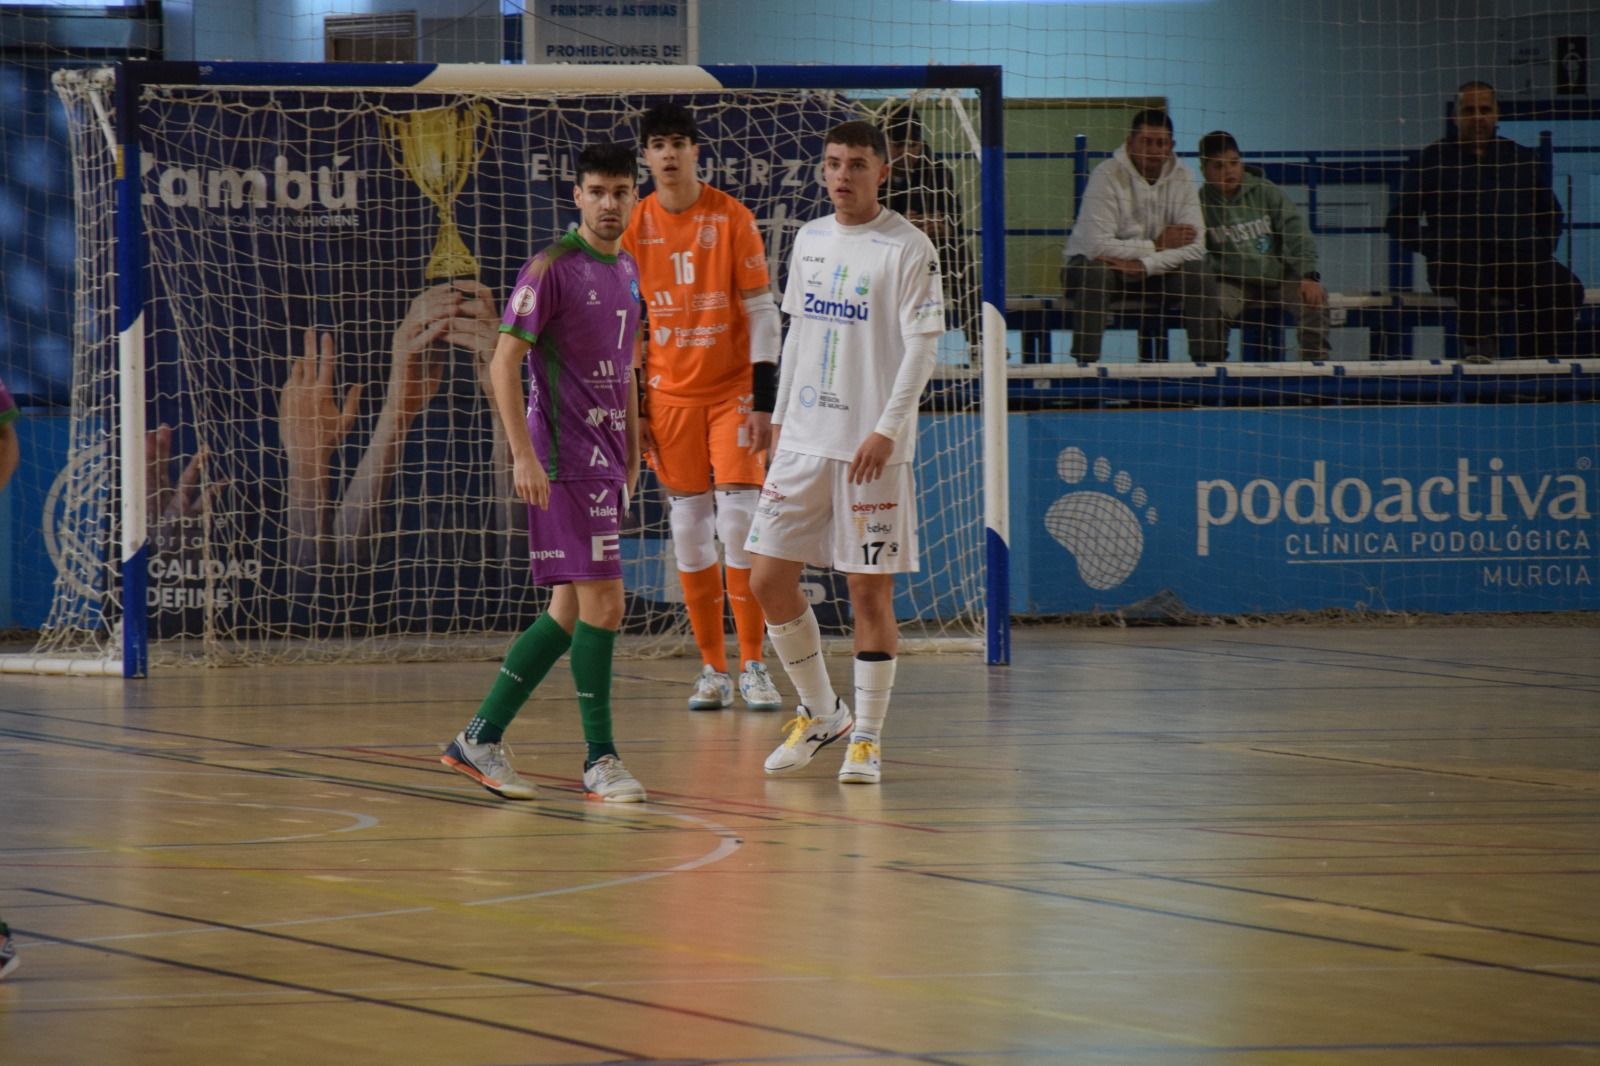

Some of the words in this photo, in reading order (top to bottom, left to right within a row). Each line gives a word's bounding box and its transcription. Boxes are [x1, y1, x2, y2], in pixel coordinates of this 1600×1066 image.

[605, 5, 617, 16] de
[621, 5, 677, 16] ASTURIAS
[546, 45, 658, 57] PROHIBICIONES
[663, 45, 681, 57] DE
[670, 251, 695, 285] 16
[804, 293, 868, 321] Zambú
[616, 309, 627, 350] 7
[674, 322, 728, 337] Fundación
[1286, 528, 1399, 555] CLÍNICA
[1411, 525, 1591, 552] PODOLÓGICA
[861, 541, 886, 565] 17
[147, 559, 261, 579] CALIDAD
[1483, 565, 1591, 586] MURCIA
